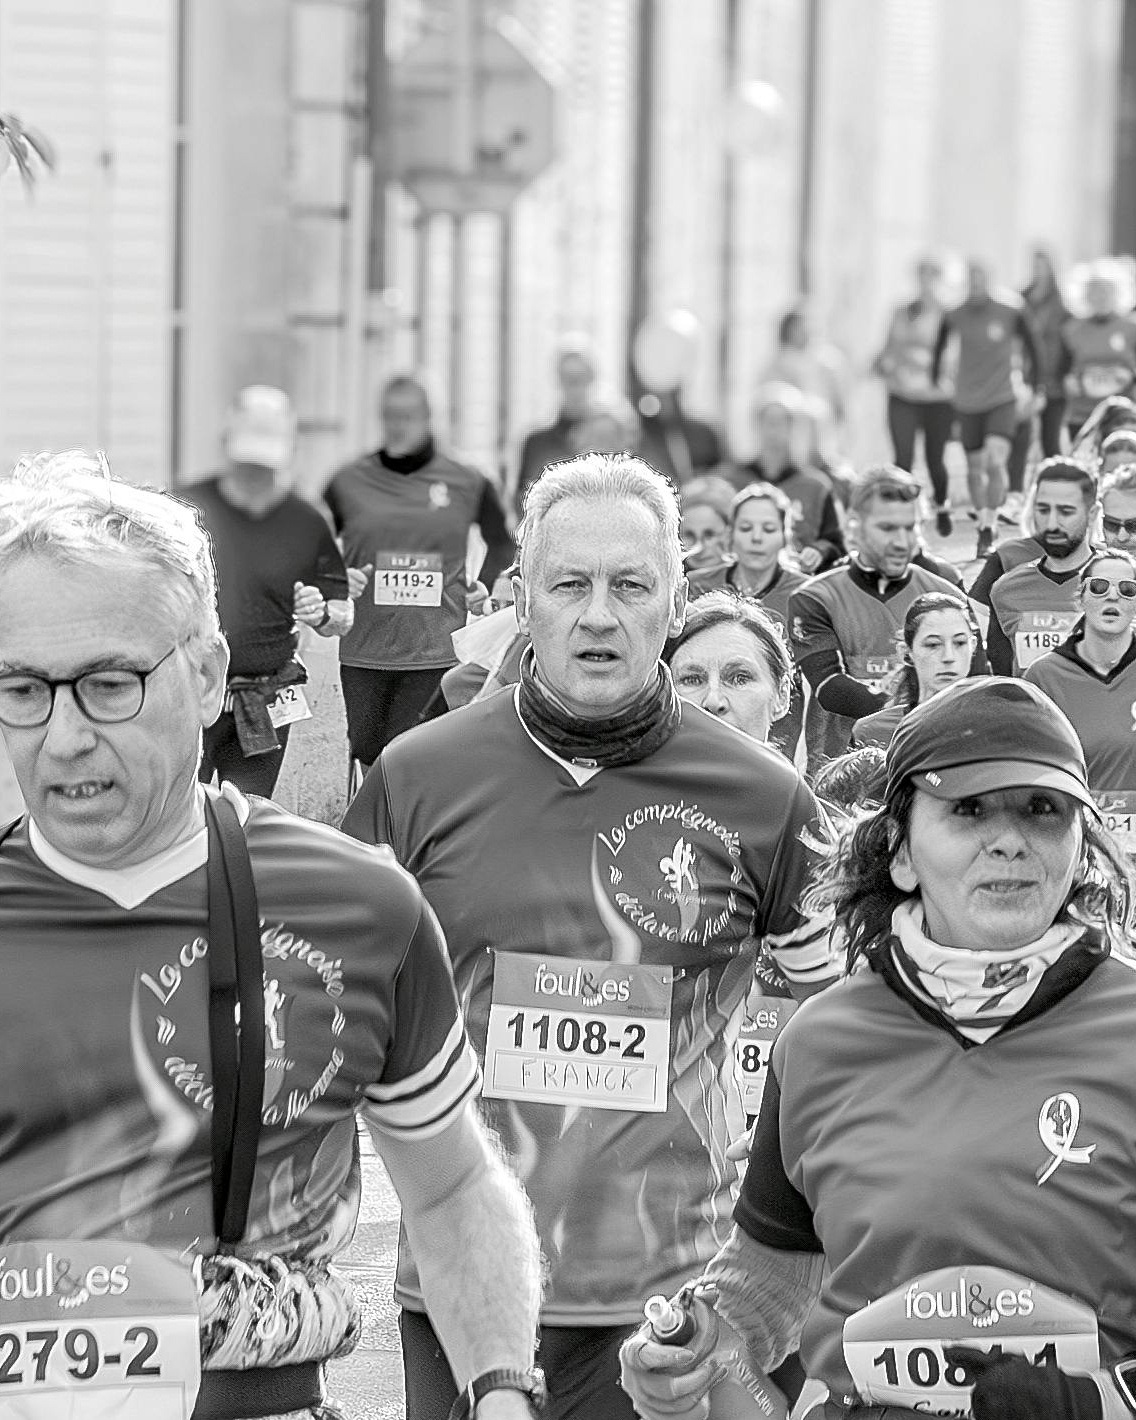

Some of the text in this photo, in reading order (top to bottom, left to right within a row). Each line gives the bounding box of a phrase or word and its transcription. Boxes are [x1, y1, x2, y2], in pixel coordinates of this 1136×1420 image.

[382, 573, 434, 587] 1119-2
[139, 963, 182, 1006] La
[507, 1012, 646, 1059] 1108-2
[521, 1057, 639, 1092] FRANCK
